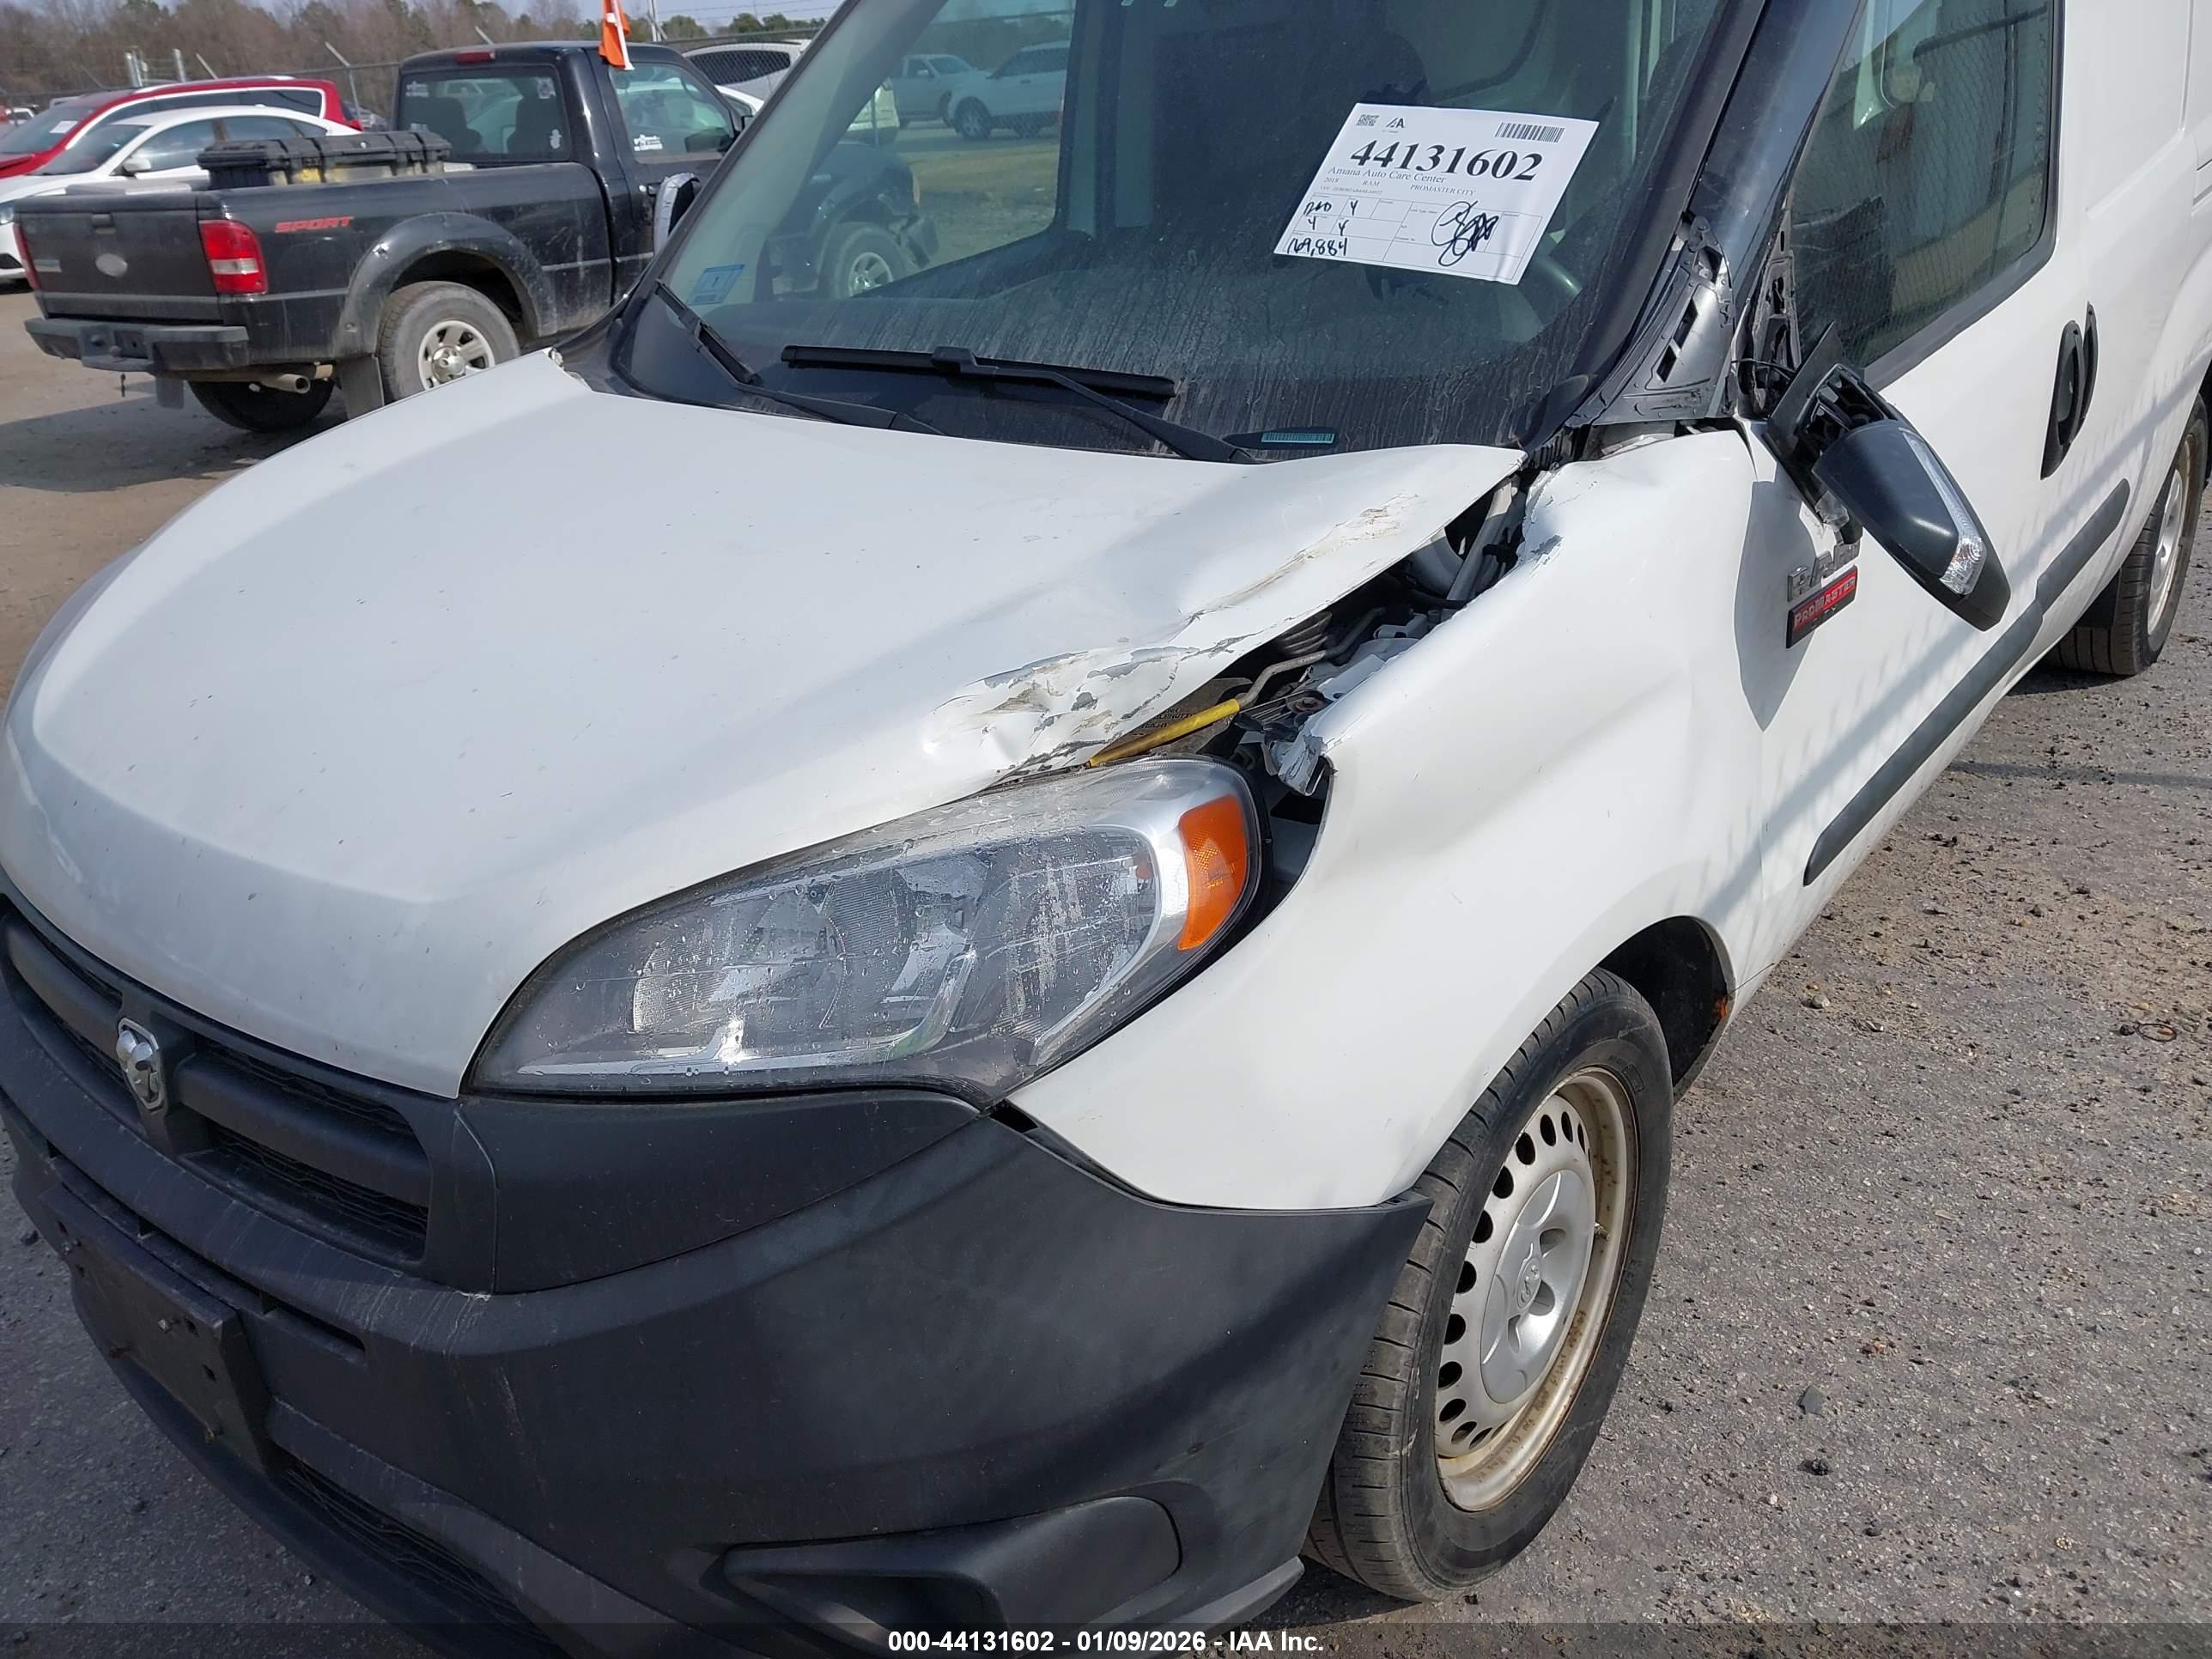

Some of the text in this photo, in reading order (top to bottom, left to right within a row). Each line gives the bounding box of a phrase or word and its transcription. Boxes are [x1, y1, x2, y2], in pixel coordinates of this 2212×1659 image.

[1350, 140, 1543, 181] 44131602
[1328, 167, 1447, 184] Amana Auto Care Center
[1410, 184, 1455, 194] PROMASTER
[275, 216, 354, 234] SPORT
